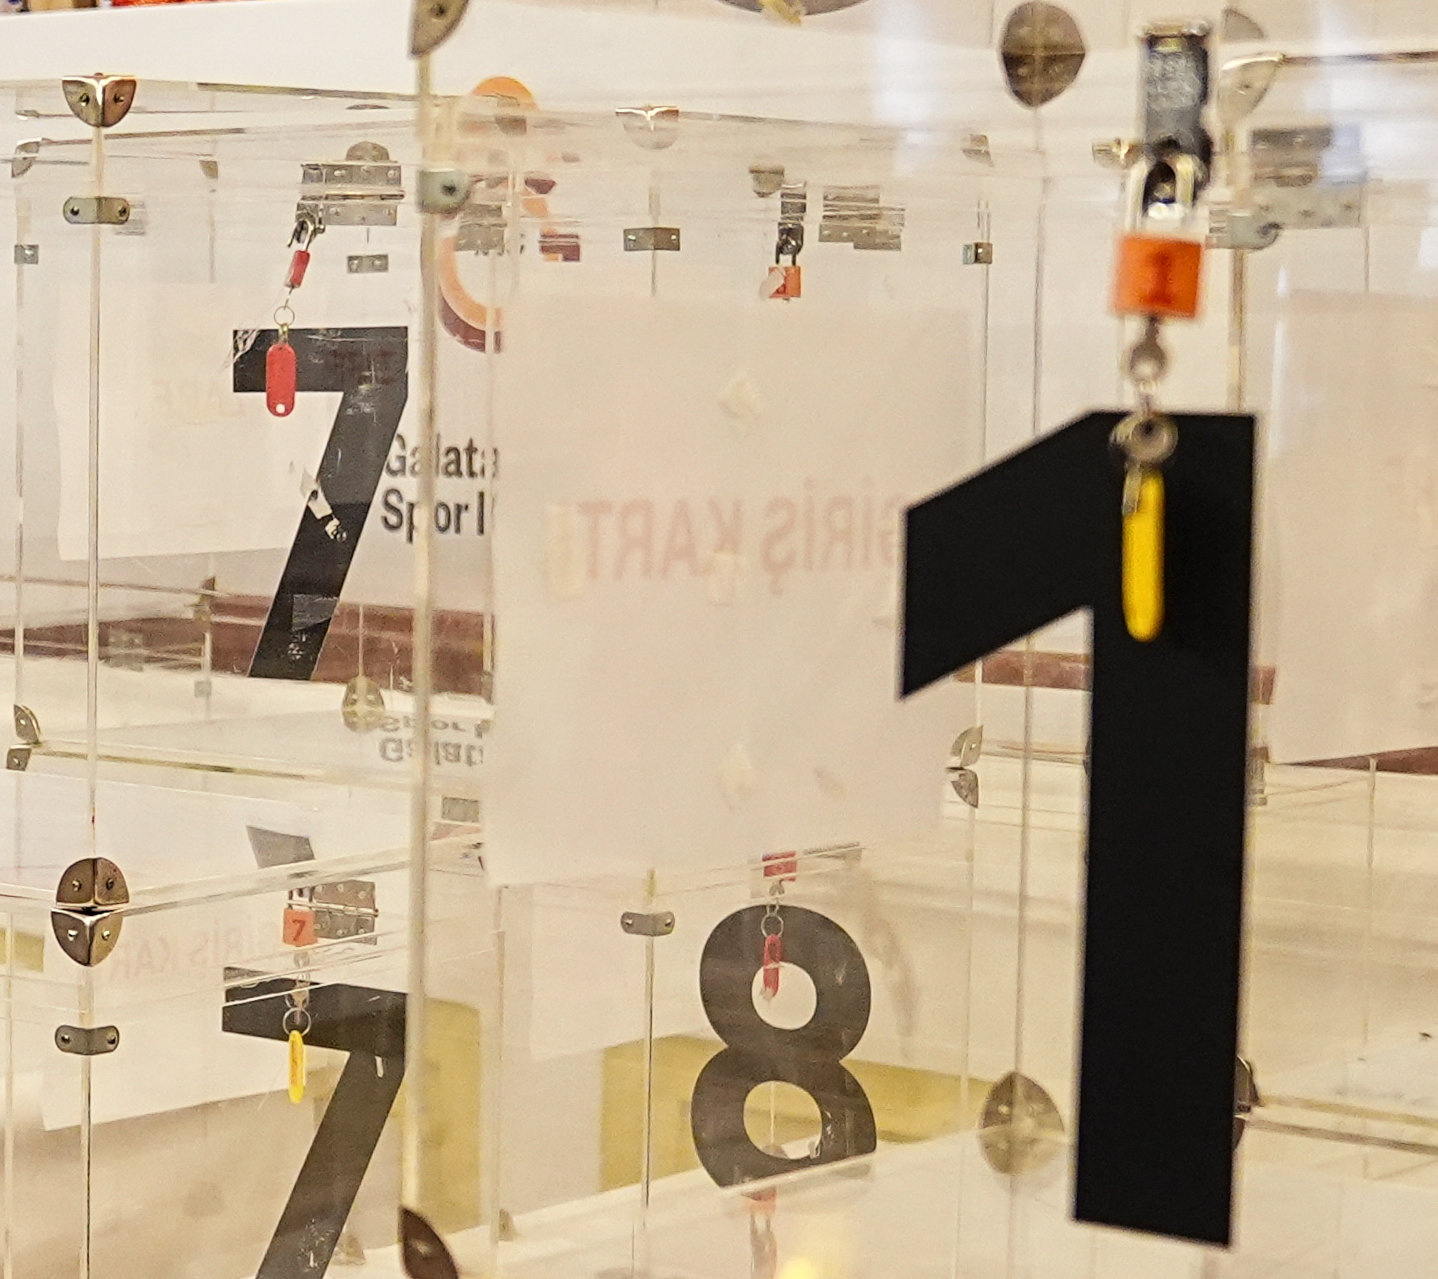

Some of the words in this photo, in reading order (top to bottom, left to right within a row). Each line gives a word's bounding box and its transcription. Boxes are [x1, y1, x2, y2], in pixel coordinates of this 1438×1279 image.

[232, 325, 409, 681] 7
[291, 918, 307, 943] 7
[900, 409, 1258, 1249] 1
[691, 904, 877, 1189] 8
